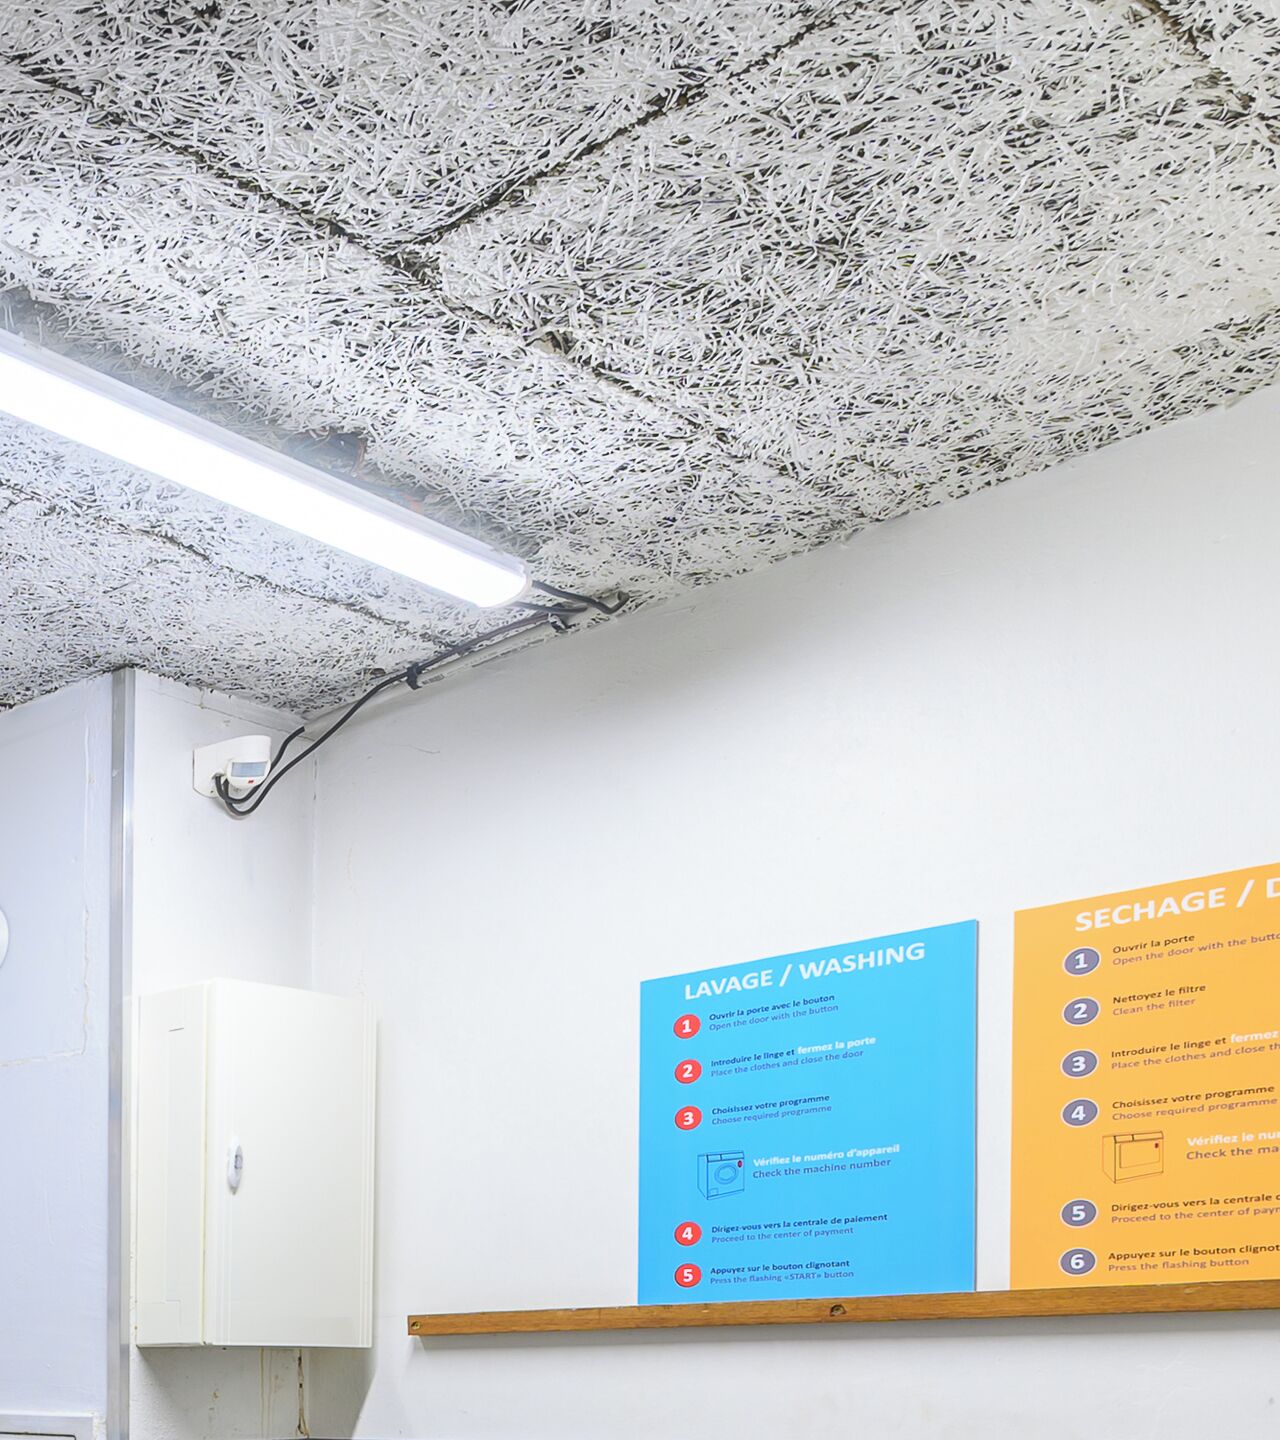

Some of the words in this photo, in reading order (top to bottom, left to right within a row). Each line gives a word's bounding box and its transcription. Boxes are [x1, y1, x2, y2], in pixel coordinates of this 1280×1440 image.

[1075, 887, 1226, 932] SECHAGE
[1236, 880, 1254, 907] /
[1113, 941, 1148, 952] Ouvrir
[1151, 939, 1160, 947] la
[1164, 934, 1195, 947] porte
[1075, 953, 1088, 969] 1
[685, 970, 773, 1000] LAVAGE
[780, 964, 792, 987] /
[799, 942, 925, 979] WASHING
[1113, 992, 1162, 1003] Nettoyez
[1166, 988, 1175, 996] le
[1179, 985, 1206, 994] filtre
[709, 1009, 734, 1018] Ouvrir
[746, 1005, 768, 1015] porte
[802, 996, 834, 1005] bouton
[1074, 1003, 1088, 1019] 2
[682, 1019, 691, 1033] 1
[710, 1055, 752, 1065] Introduire
[764, 1051, 784, 1059] linge
[798, 1045, 832, 1054] fermez
[835, 1041, 844, 1049] la
[847, 1038, 876, 1049] porte
[682, 1064, 693, 1078] 2
[1072, 1057, 1086, 1072] 3
[712, 1104, 752, 1113] Choisissez
[779, 1096, 829, 1108] programme
[1071, 1105, 1086, 1120] 4
[683, 1112, 694, 1125] 3
[754, 1155, 790, 1165] Vérifiez
[793, 1153, 801, 1161] le
[804, 1150, 844, 1160] numéro
[847, 1144, 899, 1157] d'appareil
[752, 1167, 781, 1177] Check
[784, 1166, 800, 1174] the
[803, 1163, 846, 1173] machine
[850, 1158, 891, 1169] number
[1072, 1206, 1085, 1221] 5
[712, 1224, 761, 1233] Dirigez-vous
[793, 1218, 827, 1226] centrale
[844, 1214, 887, 1225] paiement
[682, 1227, 693, 1240] 4
[710, 1267, 744, 1275] Appuyez
[806, 1260, 849, 1270] clignotant
[1070, 1254, 1084, 1269] 6
[683, 1269, 693, 1282] 5
